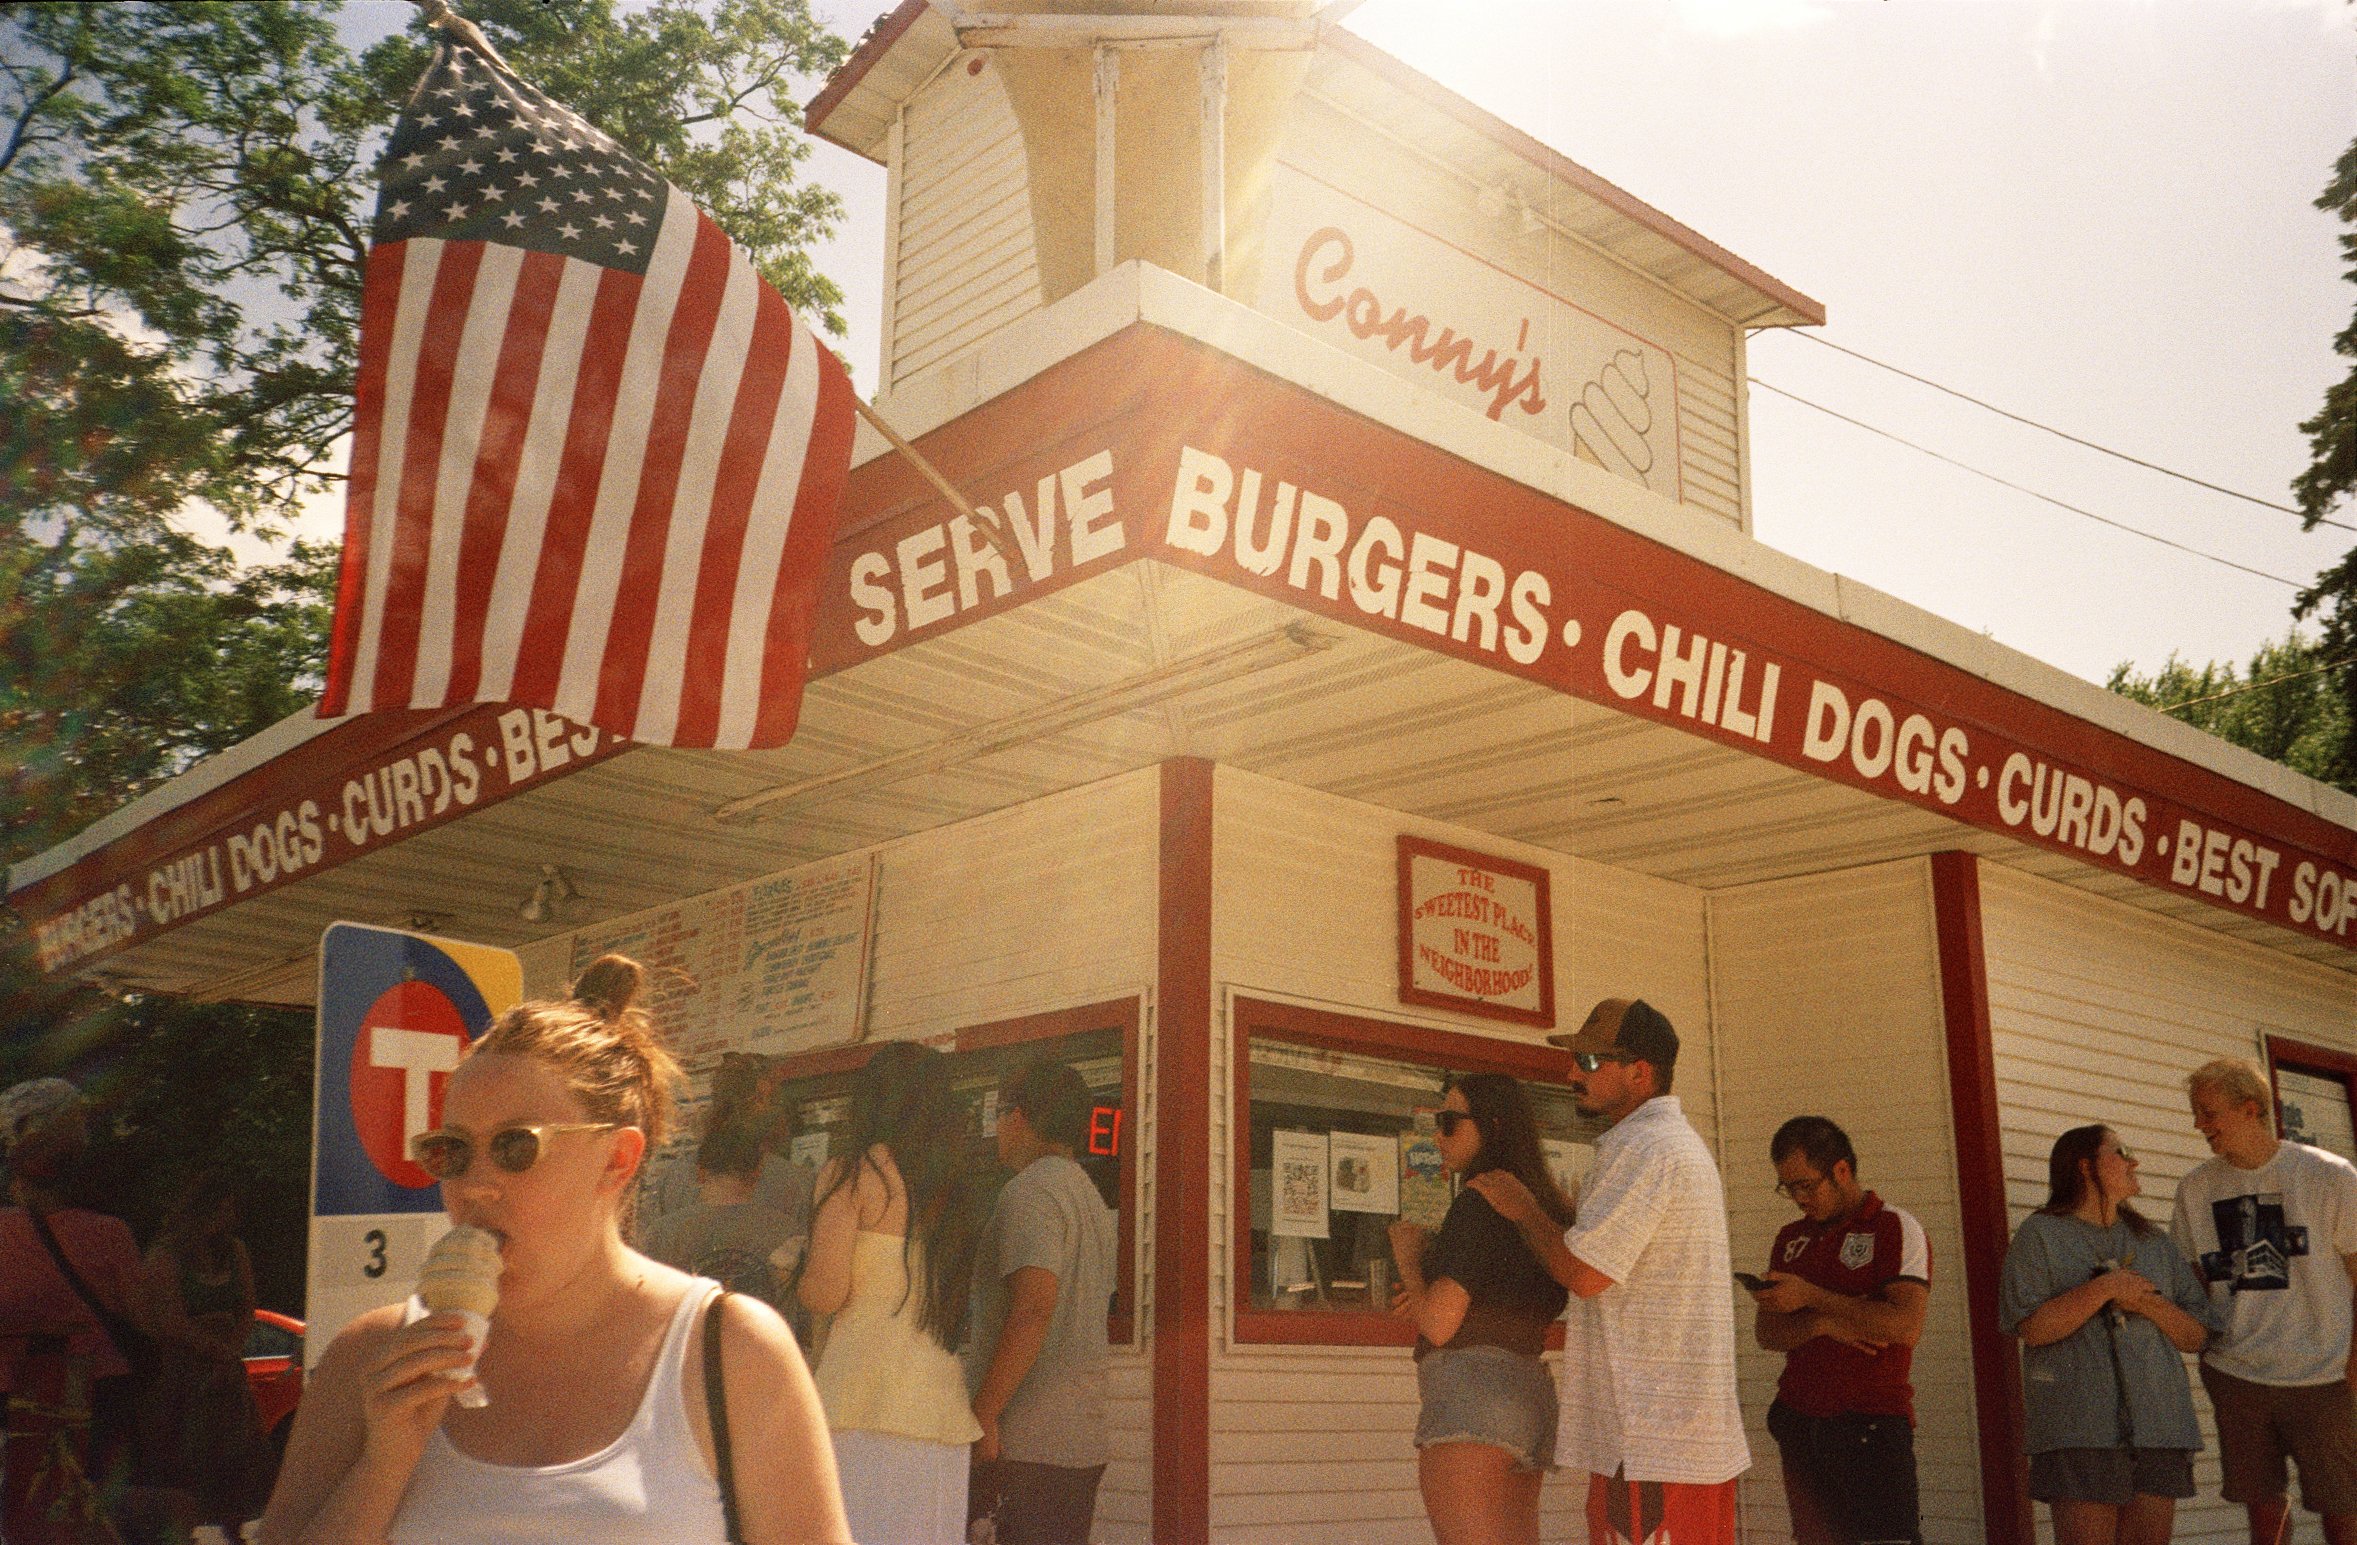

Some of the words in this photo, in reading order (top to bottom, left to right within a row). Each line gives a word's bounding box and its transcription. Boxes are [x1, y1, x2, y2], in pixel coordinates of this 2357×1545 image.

[1295, 227, 1546, 421] Conny's
[148, 846, 223, 925] CHILI
[226, 799, 322, 893] DOGS
[342, 733, 480, 846] CURDS
[497, 708, 626, 785] BES
[849, 448, 1127, 647] SERVE
[1164, 445, 1551, 664] BURGERS
[1602, 609, 1781, 744] CHILI
[1800, 679, 1970, 804] DOGS
[1998, 752, 2148, 866] CURDS
[2171, 818, 2281, 910] BEST
[1456, 868, 1496, 894] THE
[1414, 890, 1490, 924] SWEETEST
[1493, 900, 1537, 947] PLACE
[1454, 927, 1471, 956] IN
[1471, 931, 1501, 963] THE
[1419, 943, 1535, 996] NEIGHBORHOOD
[369, 1026, 461, 1162] T
[363, 1229, 388, 1278] 3
[1784, 1235, 1812, 1263] 87
